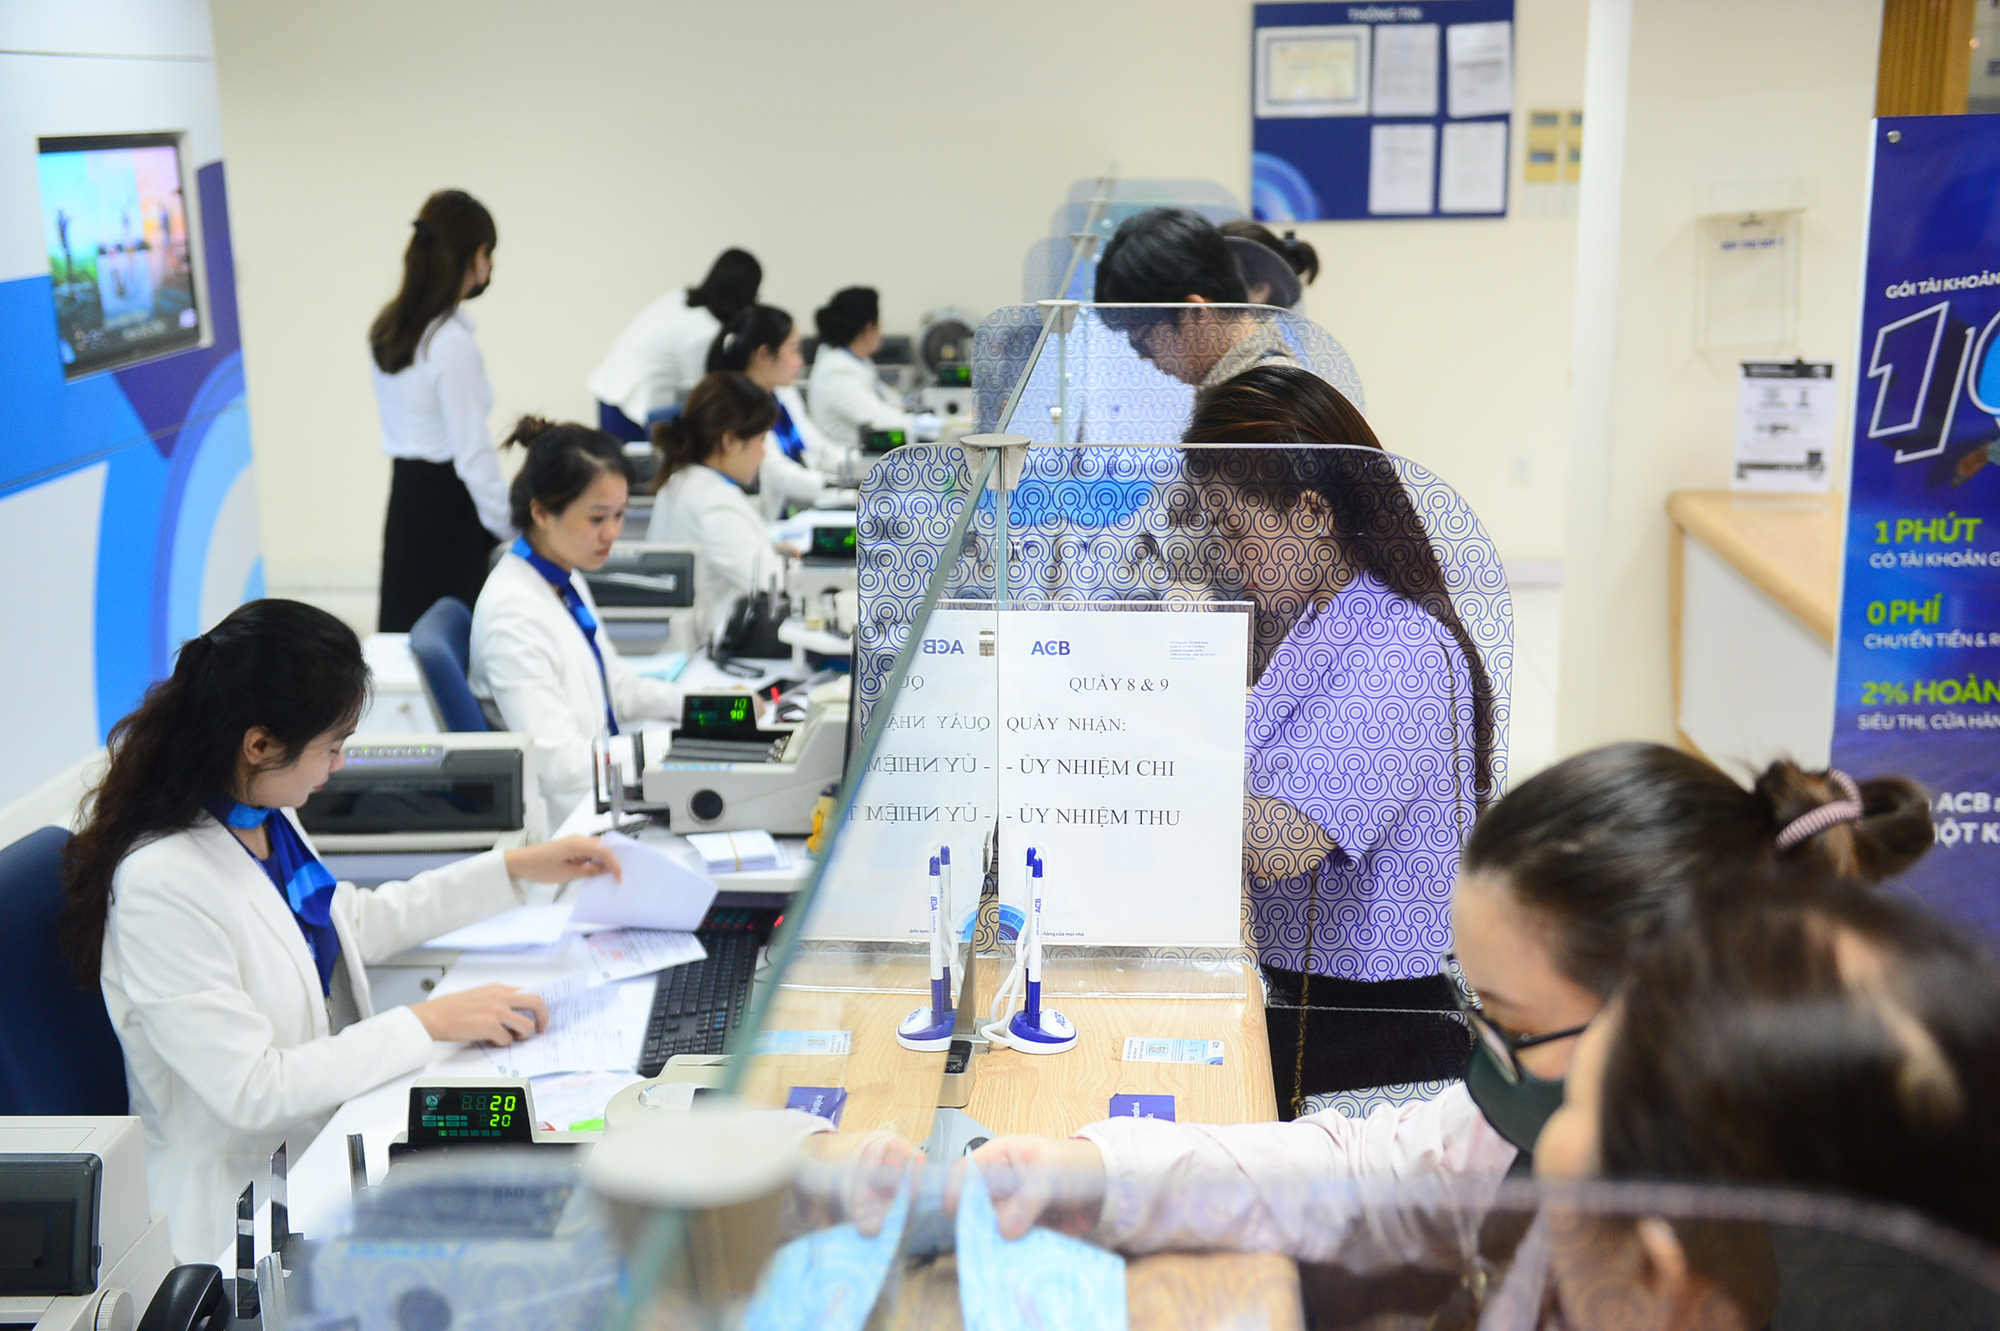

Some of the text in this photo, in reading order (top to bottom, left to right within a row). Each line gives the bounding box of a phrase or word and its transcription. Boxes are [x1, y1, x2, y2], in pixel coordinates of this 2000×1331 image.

[1885, 280, 1916, 299] GÓI
[1918, 277, 1942, 294] TÀI
[1875, 511, 1983, 543] 1 PHÚT
[1869, 549, 1896, 569] CÓ
[1898, 549, 1923, 567] TÀI
[1925, 548, 1988, 567] KHOẢN
[1890, 592, 1943, 624] PHÍ
[1031, 640, 1071, 656] ACB
[1974, 632, 1987, 648] &
[1069, 674, 1169, 694] QUẦY 8 & 9
[1861, 681, 1909, 705] 2%
[1006, 712, 1126, 734] QUẦY NHẬN:
[1857, 711, 1896, 731] SIÊU
[1020, 753, 1050, 774] ỦY
[1056, 757, 1130, 779] NHIỆM
[1136, 760, 1175, 776] CHI
[1935, 791, 1991, 813] ACB
[1020, 802, 1050, 823] ỦY
[1055, 806, 1129, 828] NHIỆM
[1134, 809, 1181, 826] THU
[489, 1095, 517, 1112] 20
[489, 1113, 512, 1127] 20
